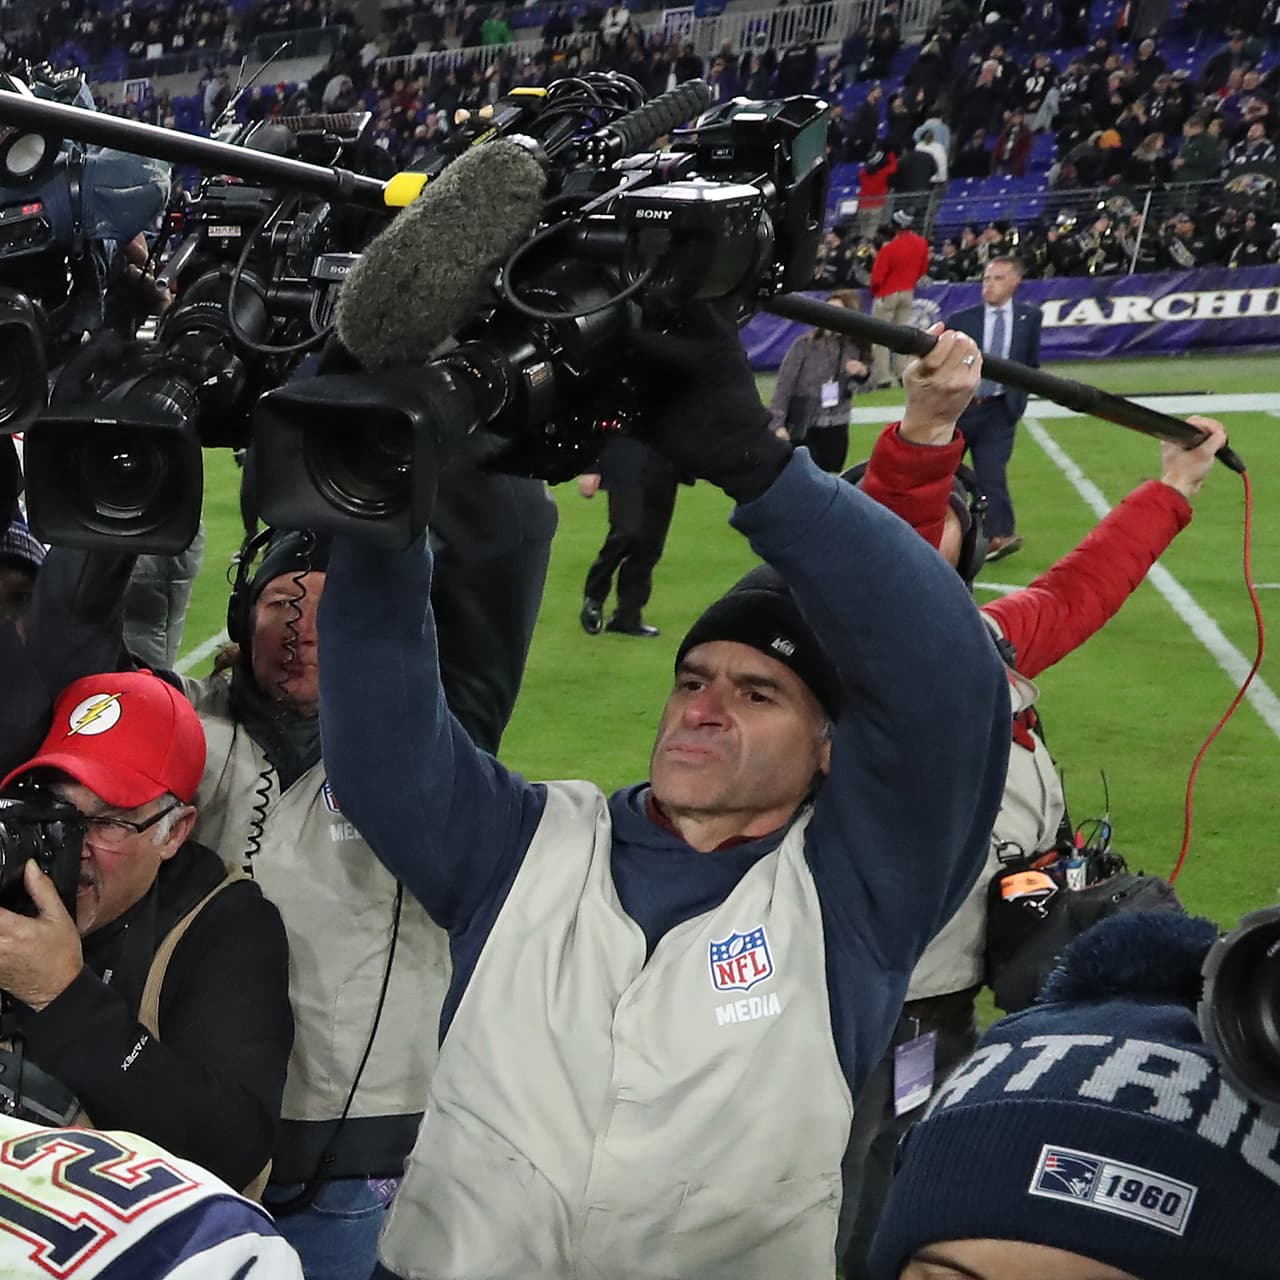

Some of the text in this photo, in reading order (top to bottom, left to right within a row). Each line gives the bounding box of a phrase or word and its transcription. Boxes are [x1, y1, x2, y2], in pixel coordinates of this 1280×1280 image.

[635, 208, 673, 221] SONY
[1040, 287, 1280, 328] ARCHI
[715, 950, 768, 986] NFL
[714, 992, 782, 1026] MEDIA
[1105, 1174, 1184, 1218] 1960
